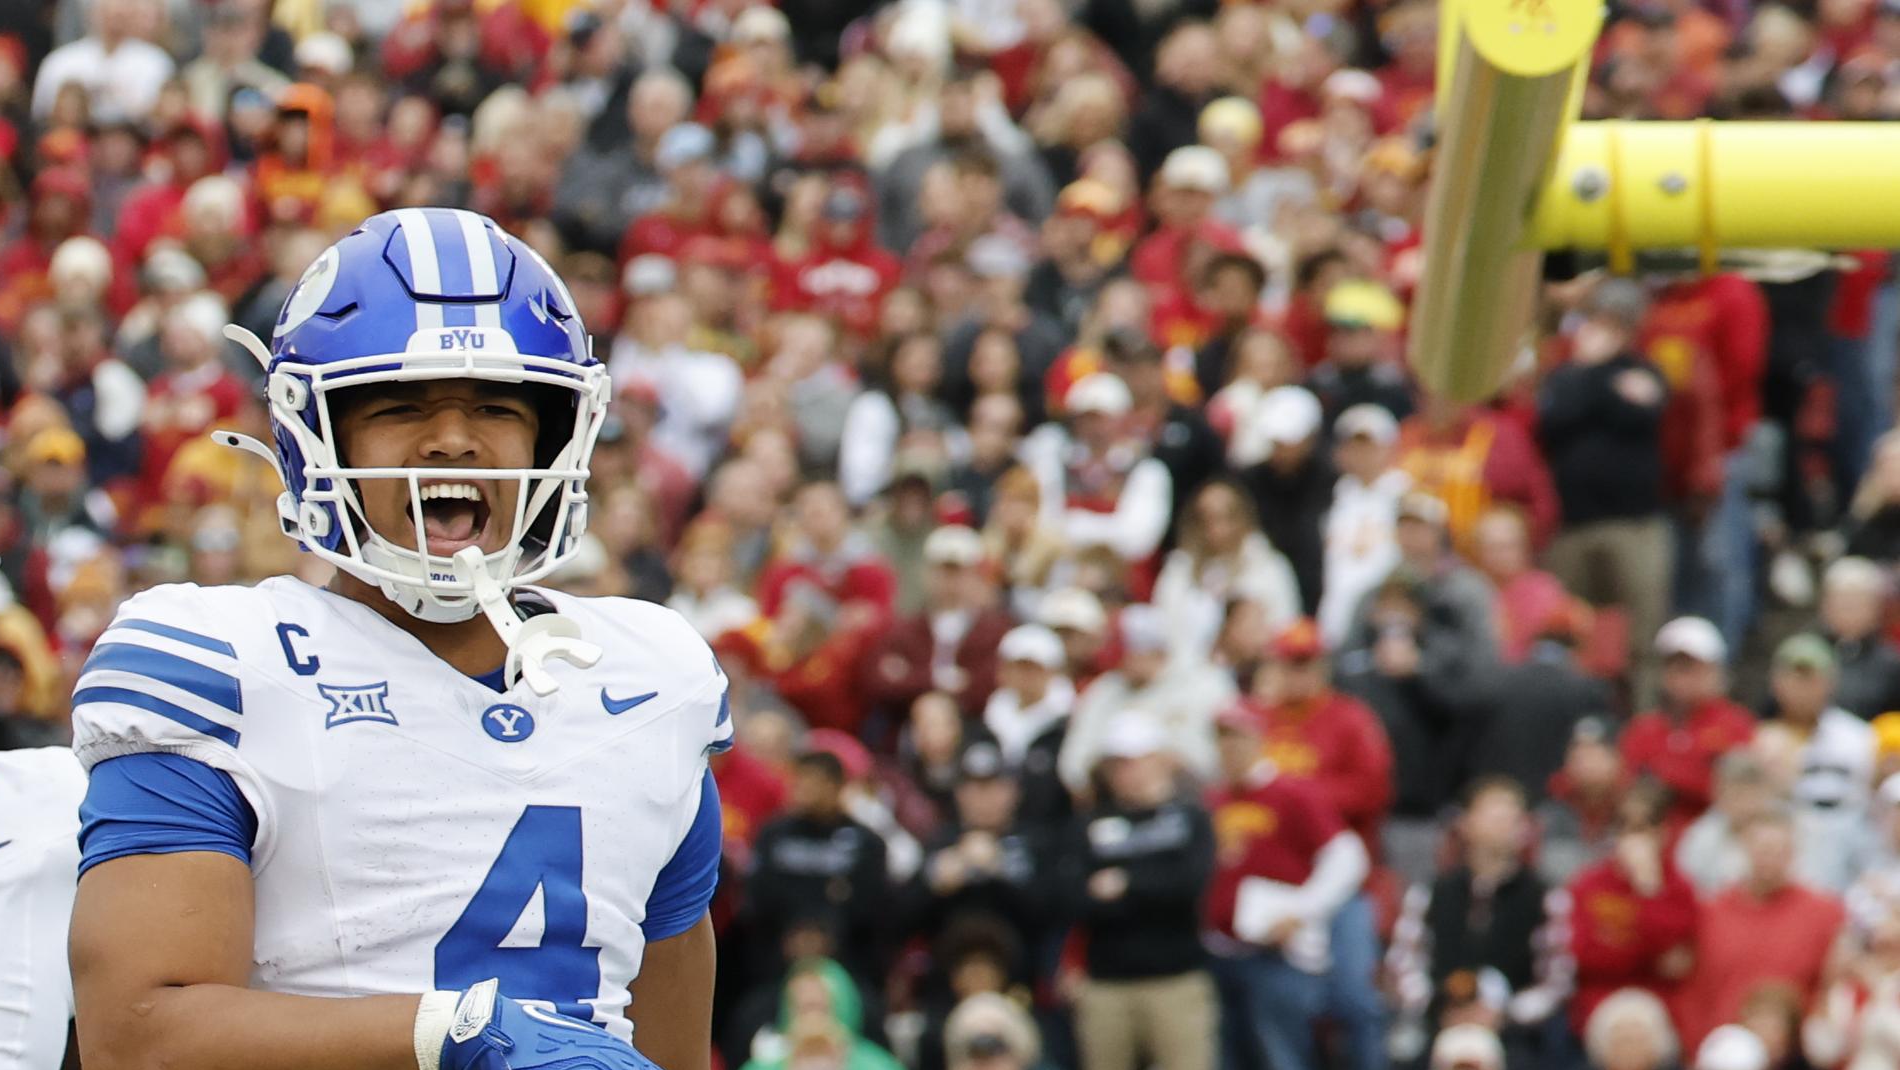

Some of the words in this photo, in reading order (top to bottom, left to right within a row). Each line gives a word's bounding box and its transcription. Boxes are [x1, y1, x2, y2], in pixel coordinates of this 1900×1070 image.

[441, 330, 484, 350] BYU
[276, 622, 320, 676] C
[317, 680, 399, 730] XII
[489, 709, 524, 736] Y
[434, 804, 608, 1029] 4
